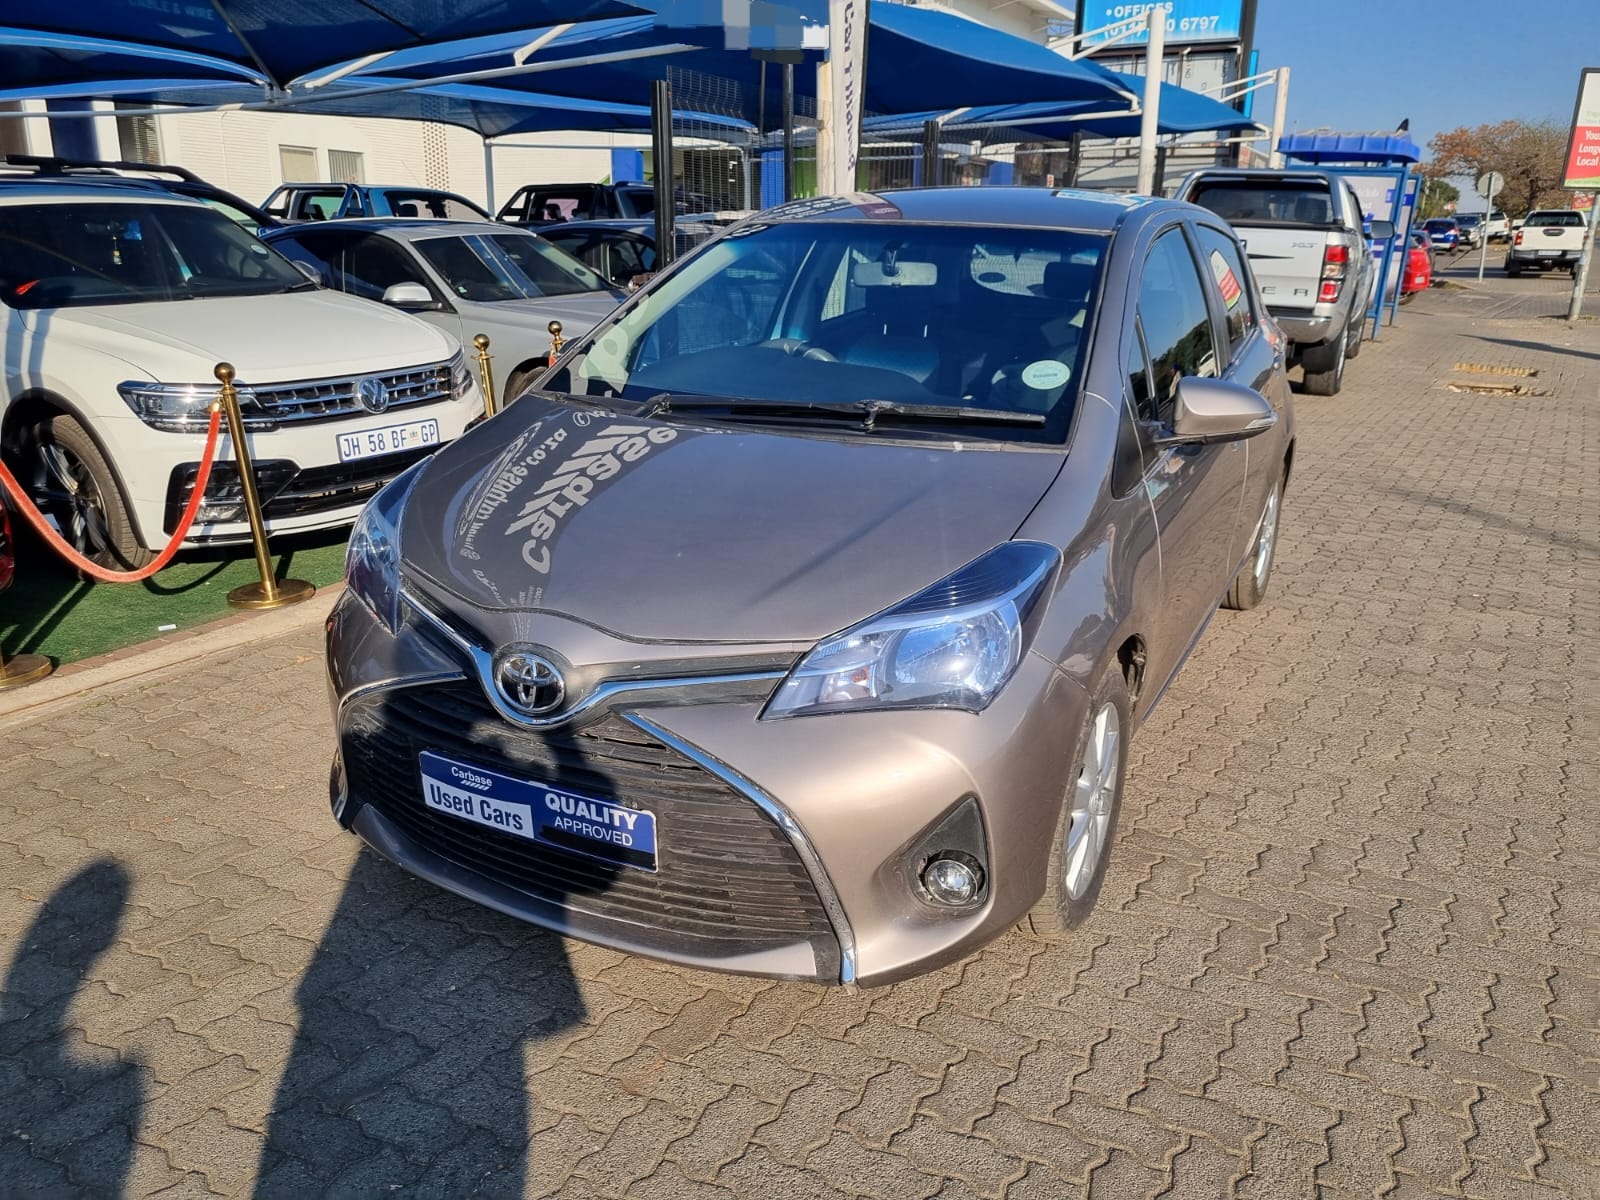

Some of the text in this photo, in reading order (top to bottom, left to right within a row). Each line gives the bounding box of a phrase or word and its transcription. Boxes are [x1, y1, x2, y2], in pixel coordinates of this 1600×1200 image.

[1180, 15, 1219, 32] 6797
[343, 423, 436, 457] JH 58 BF GP
[451, 766, 493, 787] Carbase
[430, 783, 523, 831] Used Cars
[545, 793, 639, 830] QUALITY
[554, 816, 633, 847] APPROVED
